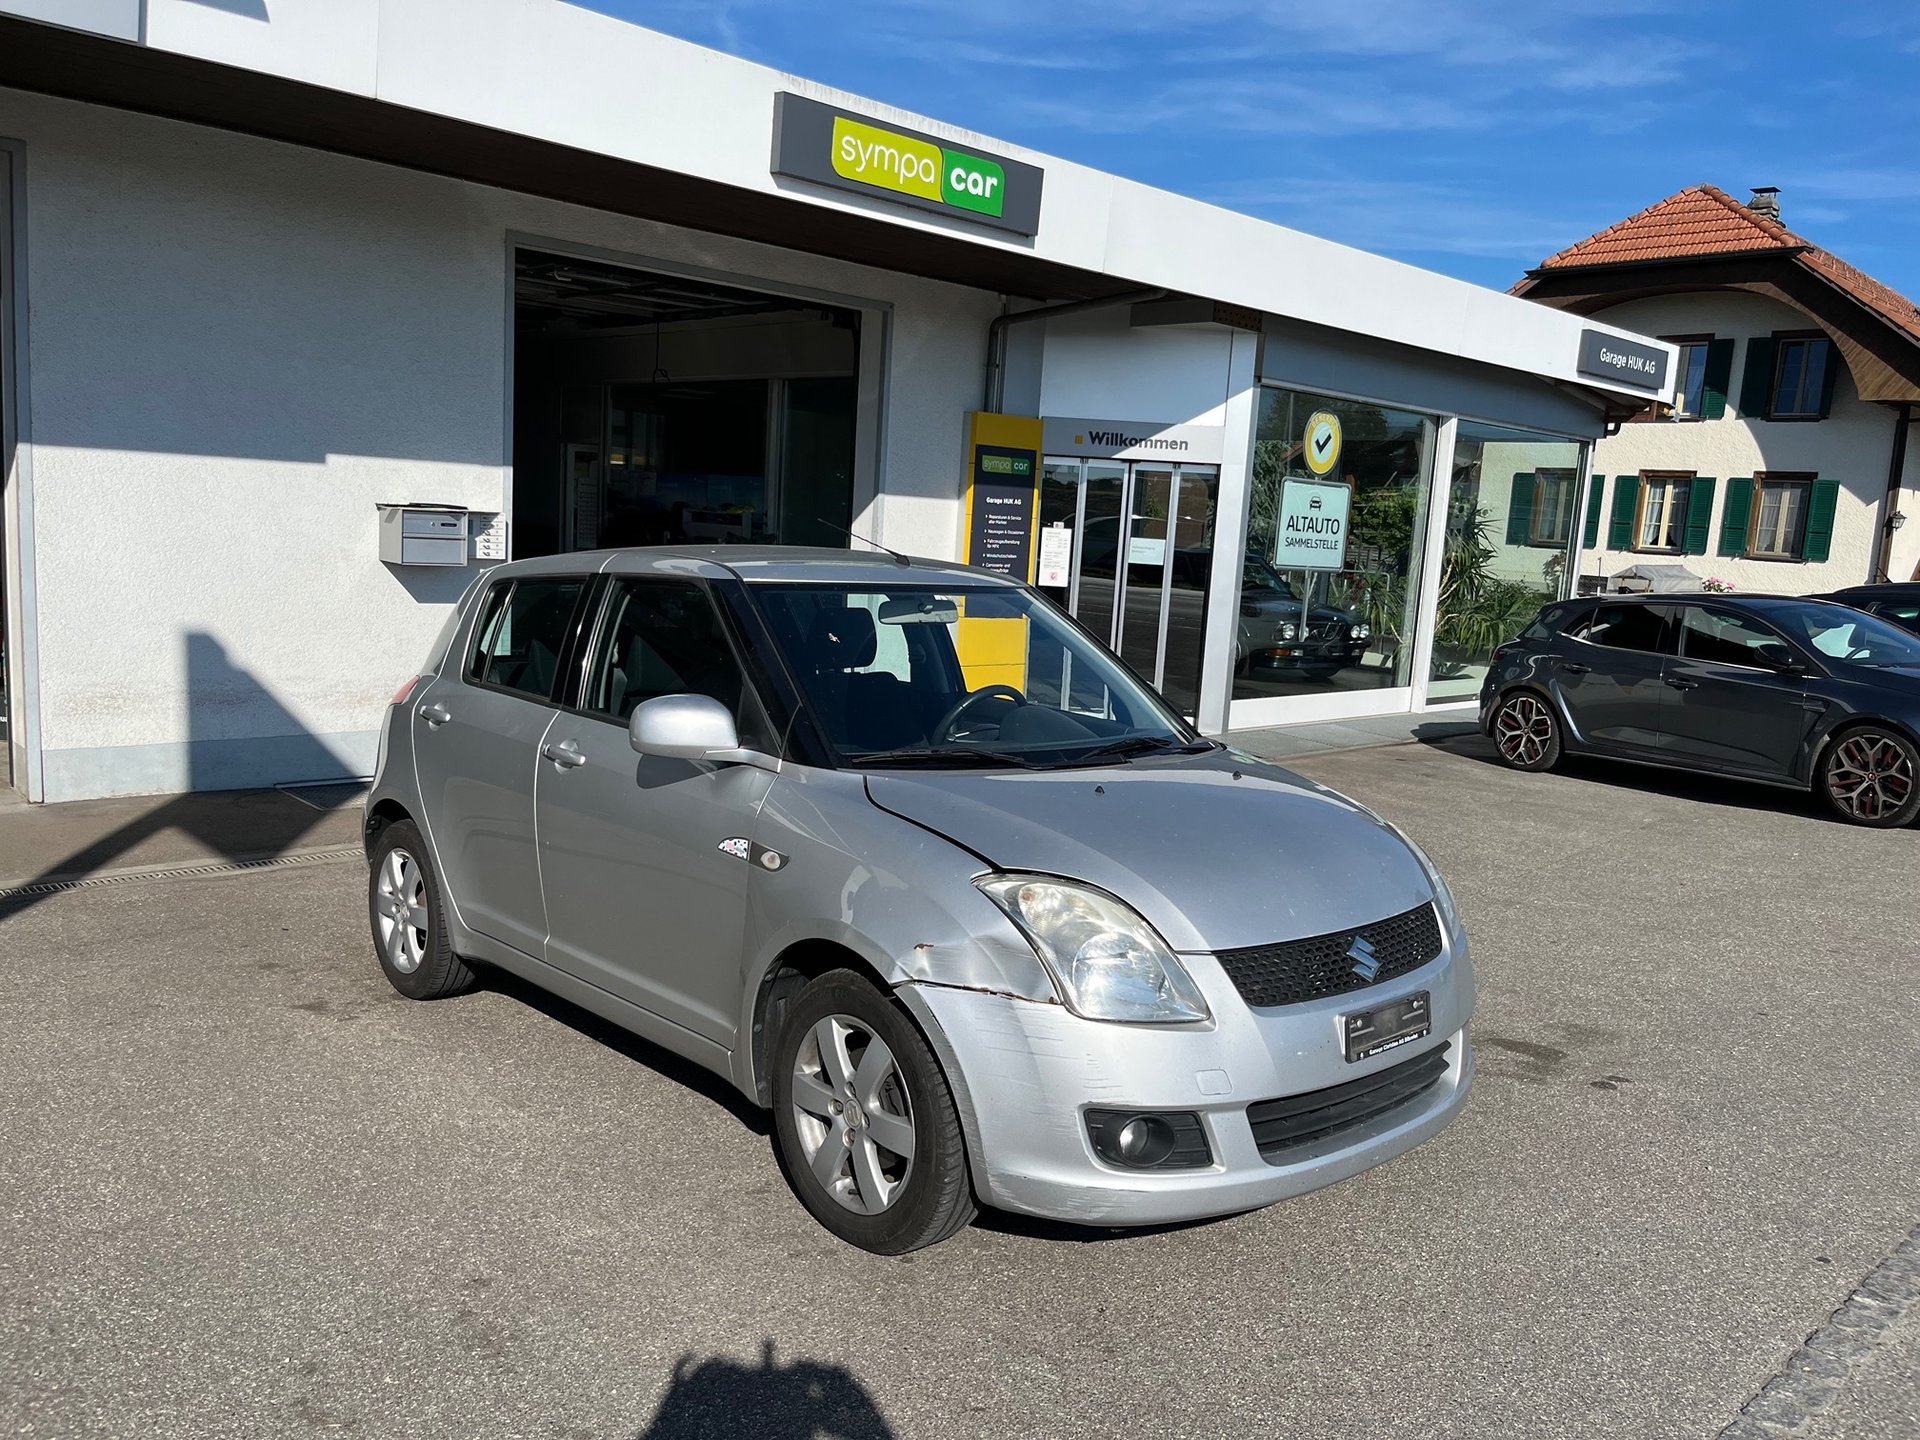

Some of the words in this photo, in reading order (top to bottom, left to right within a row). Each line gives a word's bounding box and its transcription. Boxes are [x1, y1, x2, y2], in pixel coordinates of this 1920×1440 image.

[841, 135, 935, 184] sympa
[950, 167, 998, 198] car
[1600, 347, 1627, 368] Garage
[1627, 355, 1644, 371] HUK
[1644, 360, 1656, 374] AG
[1088, 430, 1189, 451] Willkommen
[984, 460, 1010, 471] sympa
[1013, 462, 1028, 470] car
[986, 496, 1003, 504] Garage
[1286, 514, 1340, 535] ALTAUTO
[1285, 536, 1339, 550] SAMMELSTELLE
